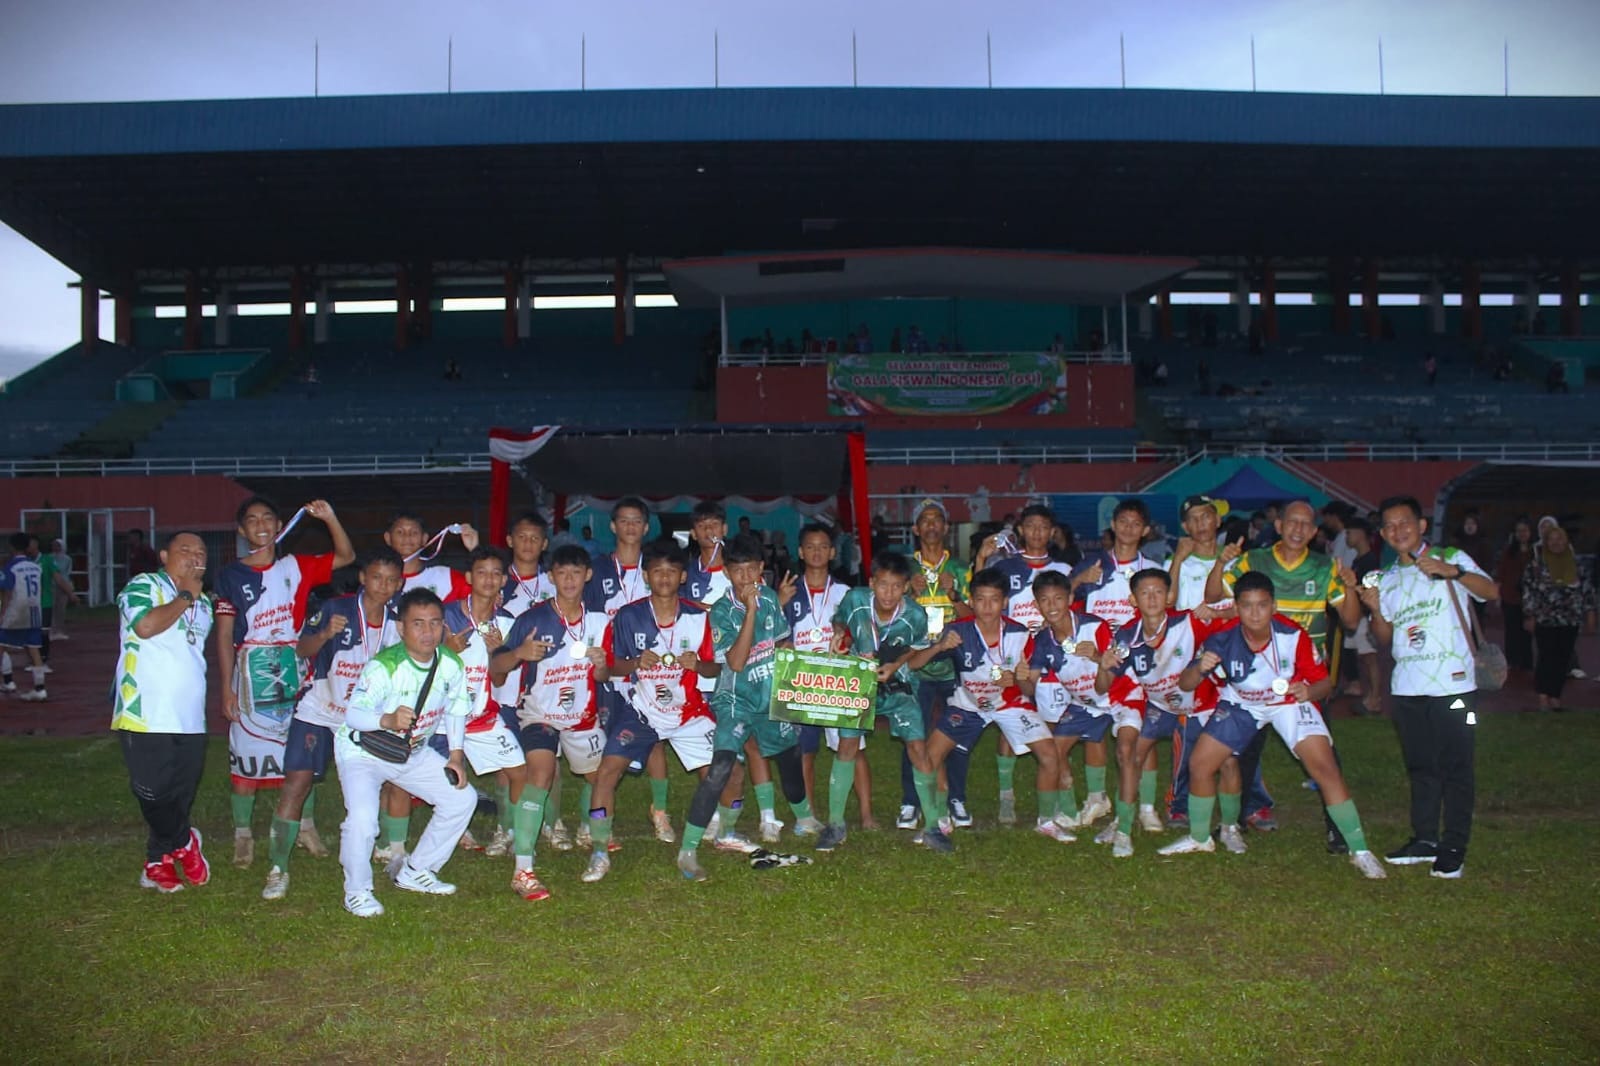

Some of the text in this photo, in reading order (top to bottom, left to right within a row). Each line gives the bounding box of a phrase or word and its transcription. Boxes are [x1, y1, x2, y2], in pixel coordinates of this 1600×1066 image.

[891, 374, 934, 386] SISWA
[935, 373, 1005, 386] INDONESIA
[25, 574, 39, 598] 15
[602, 578, 614, 595] 12
[691, 582, 701, 598] 6
[1010, 574, 1022, 590] 15
[241, 583, 255, 602] 5
[793, 601, 802, 618] 9
[341, 627, 353, 646] 3
[634, 632, 647, 651] 18
[1134, 654, 1148, 672] 16
[1231, 660, 1244, 678] 14
[791, 671, 861, 693] JUARA 2
[777, 690, 794, 702] RP
[793, 691, 870, 710] 8.000.000.00
[1053, 687, 1065, 703] 15
[1298, 702, 1313, 720] 14
[496, 734, 511, 749] 2
[587, 734, 600, 752] 17
